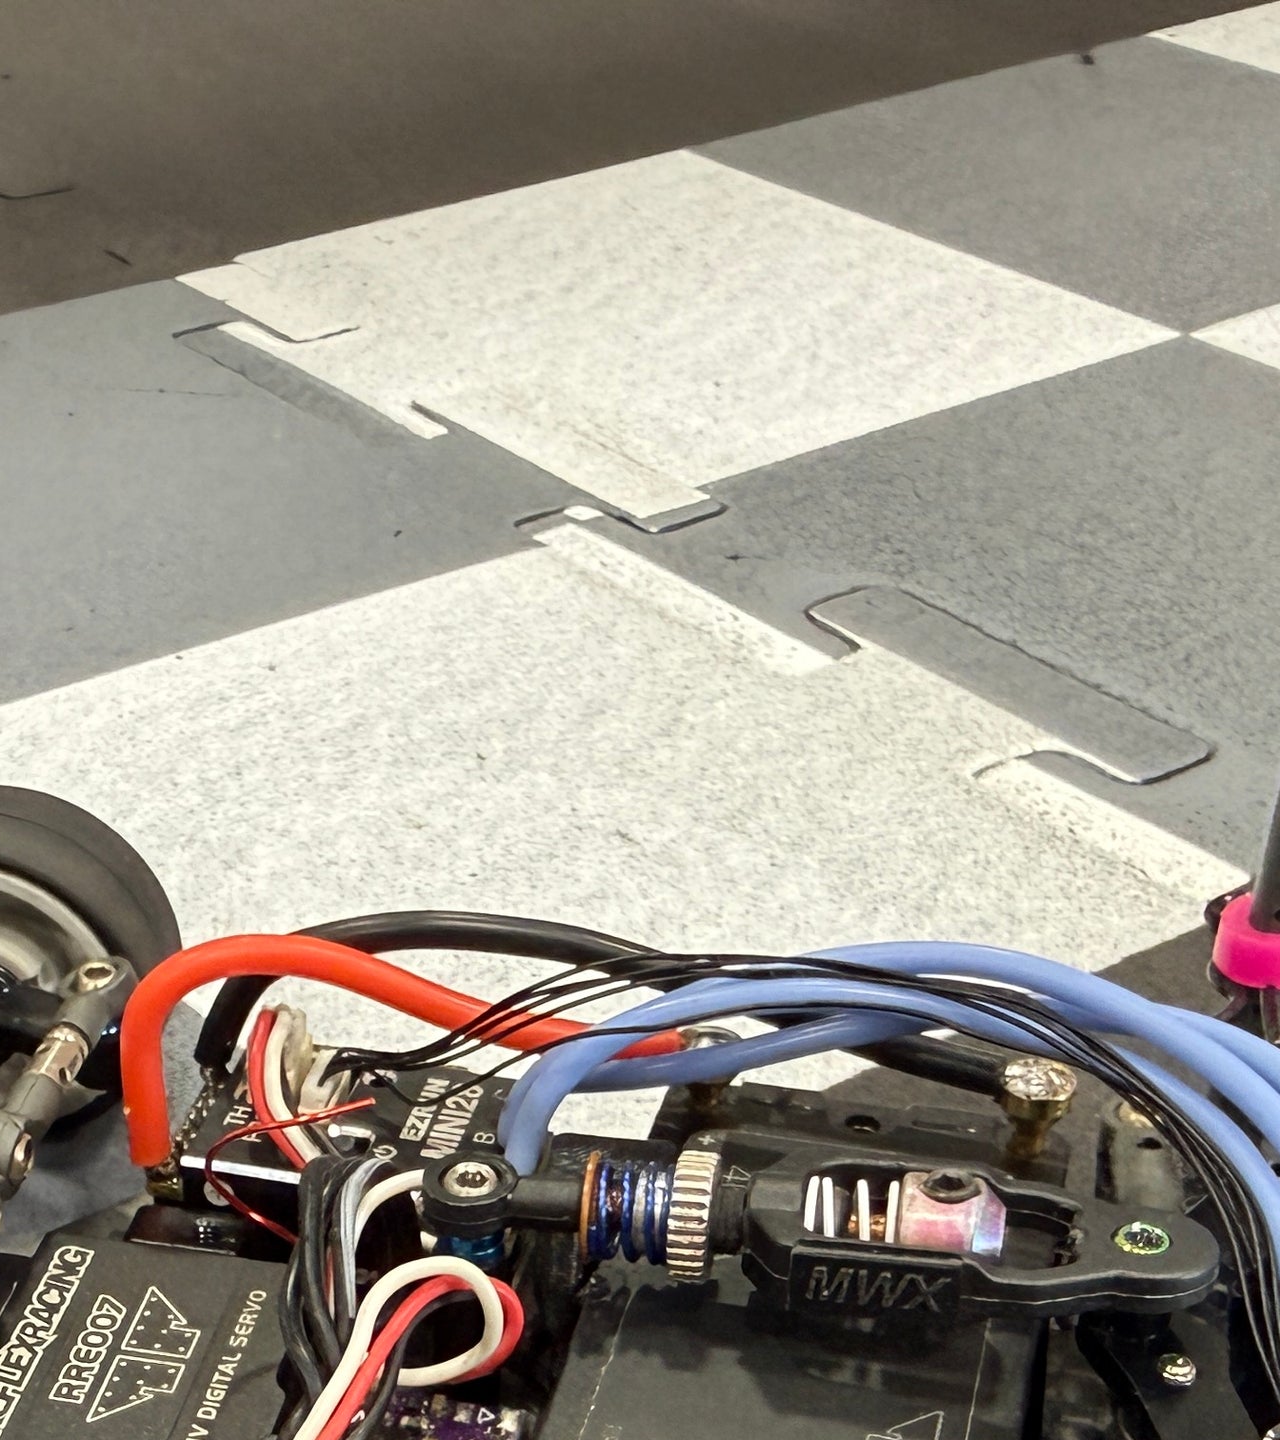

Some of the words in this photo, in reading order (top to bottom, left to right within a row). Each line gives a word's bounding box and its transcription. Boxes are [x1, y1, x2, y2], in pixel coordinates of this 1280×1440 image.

[804, 1264, 953, 1314] MWX
[48, 1293, 128, 1405] RRE007
[196, 1351, 243, 1421] DIGITAL
[228, 1289, 268, 1348] SERVO
